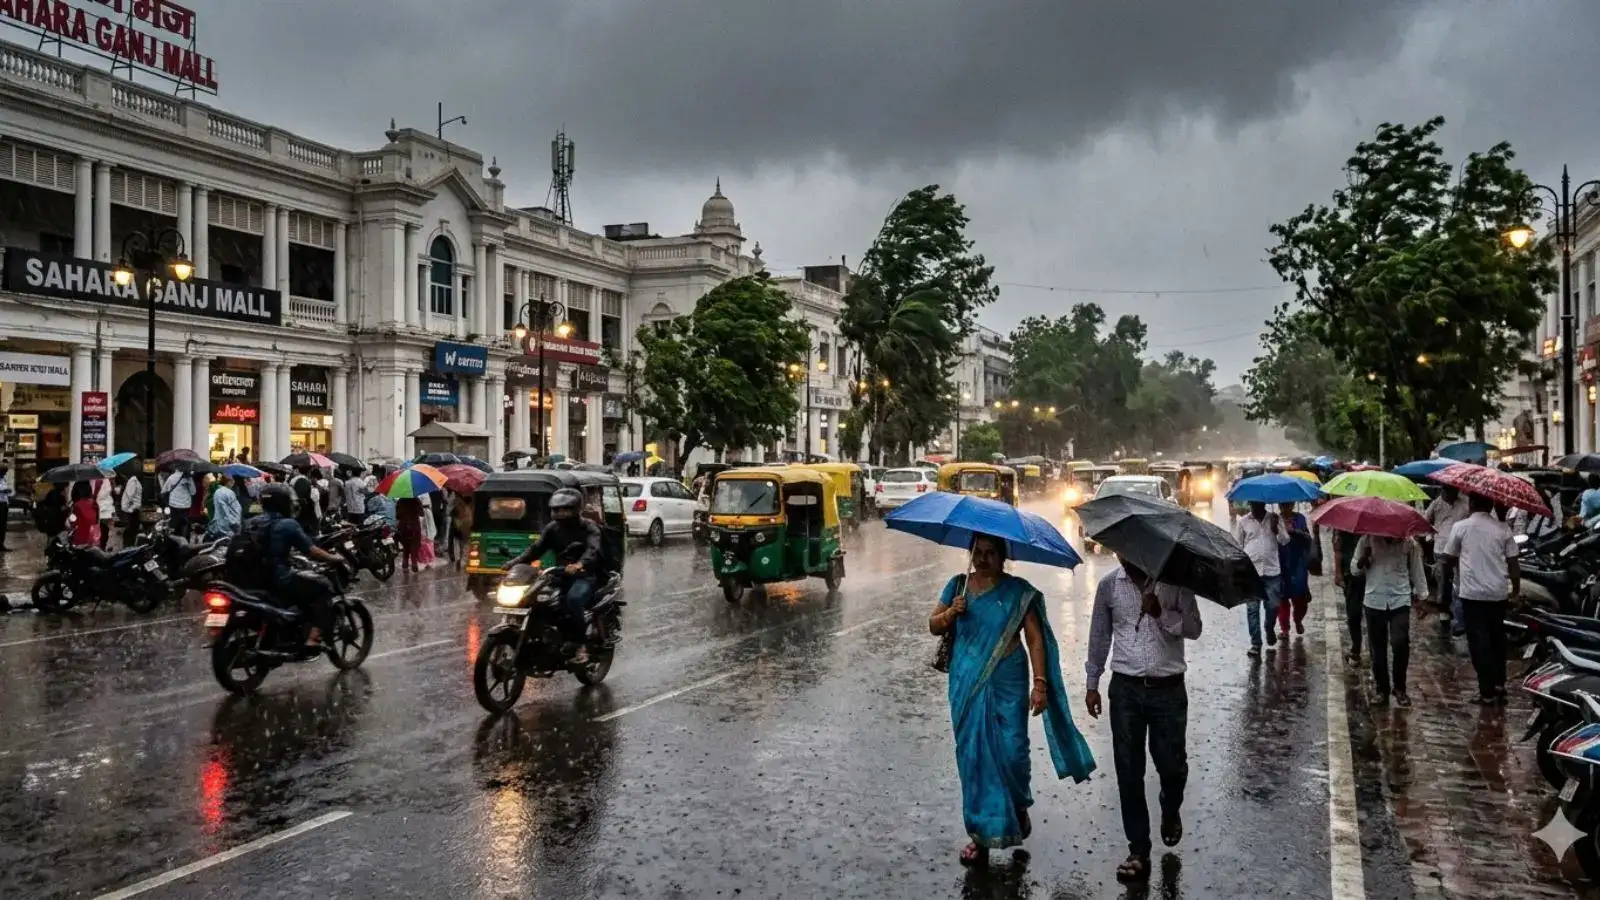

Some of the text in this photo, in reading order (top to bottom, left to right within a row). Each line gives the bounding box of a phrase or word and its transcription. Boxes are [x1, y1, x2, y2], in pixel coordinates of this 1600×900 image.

[95, 16, 157, 68] GANJ
[162, 41, 218, 90] MALL
[26, 257, 272, 318] SAHARA GANJ MALL
[291, 381, 327, 393] SAHARA
[297, 394, 323, 407] MALL
